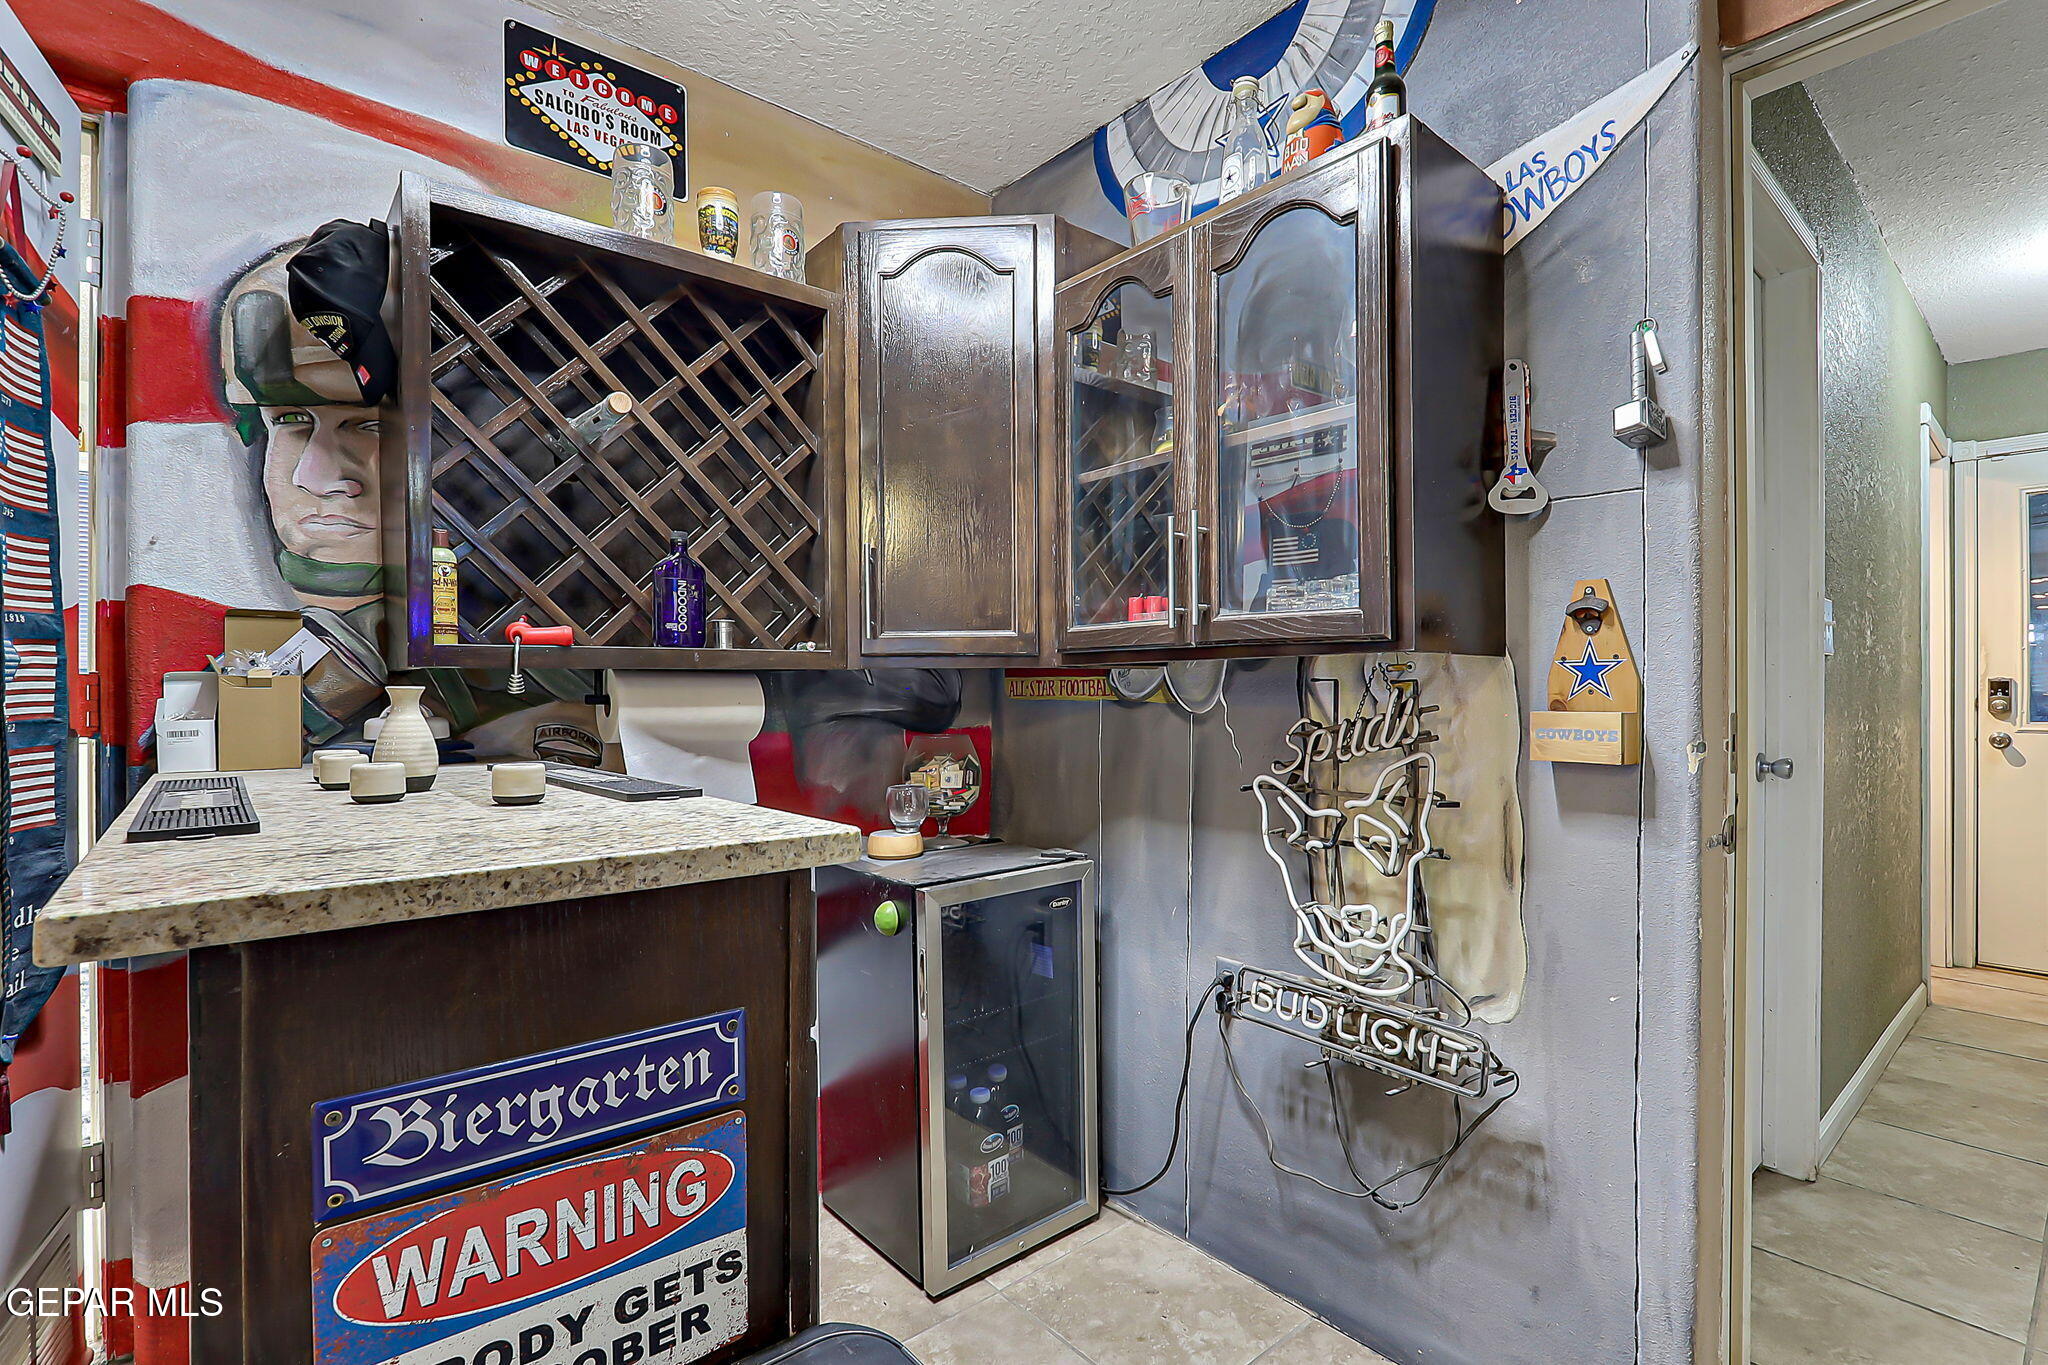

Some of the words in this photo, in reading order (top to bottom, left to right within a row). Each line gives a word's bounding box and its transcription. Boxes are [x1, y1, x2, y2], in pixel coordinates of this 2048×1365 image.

[522, 51, 673, 122] WELCOME
[562, 88, 575, 98] TO
[580, 95, 638, 122] Fabulous
[534, 88, 614, 130] SALCIDO'S
[620, 119, 661, 147] ROOM
[566, 119, 589, 137] LAS
[594, 128, 633, 147] VEGA
[1510, 428, 1519, 461] TEXAS
[677, 580, 688, 632] INDOGGO
[1535, 727, 1619, 743] COWBOYS
[1250, 980, 1330, 1030] BUD
[361, 1045, 714, 1167] Biergarten
[989, 1158, 1007, 1178] 100
[371, 1158, 707, 1320] WARNING
[613, 1249, 744, 1325] GETS
